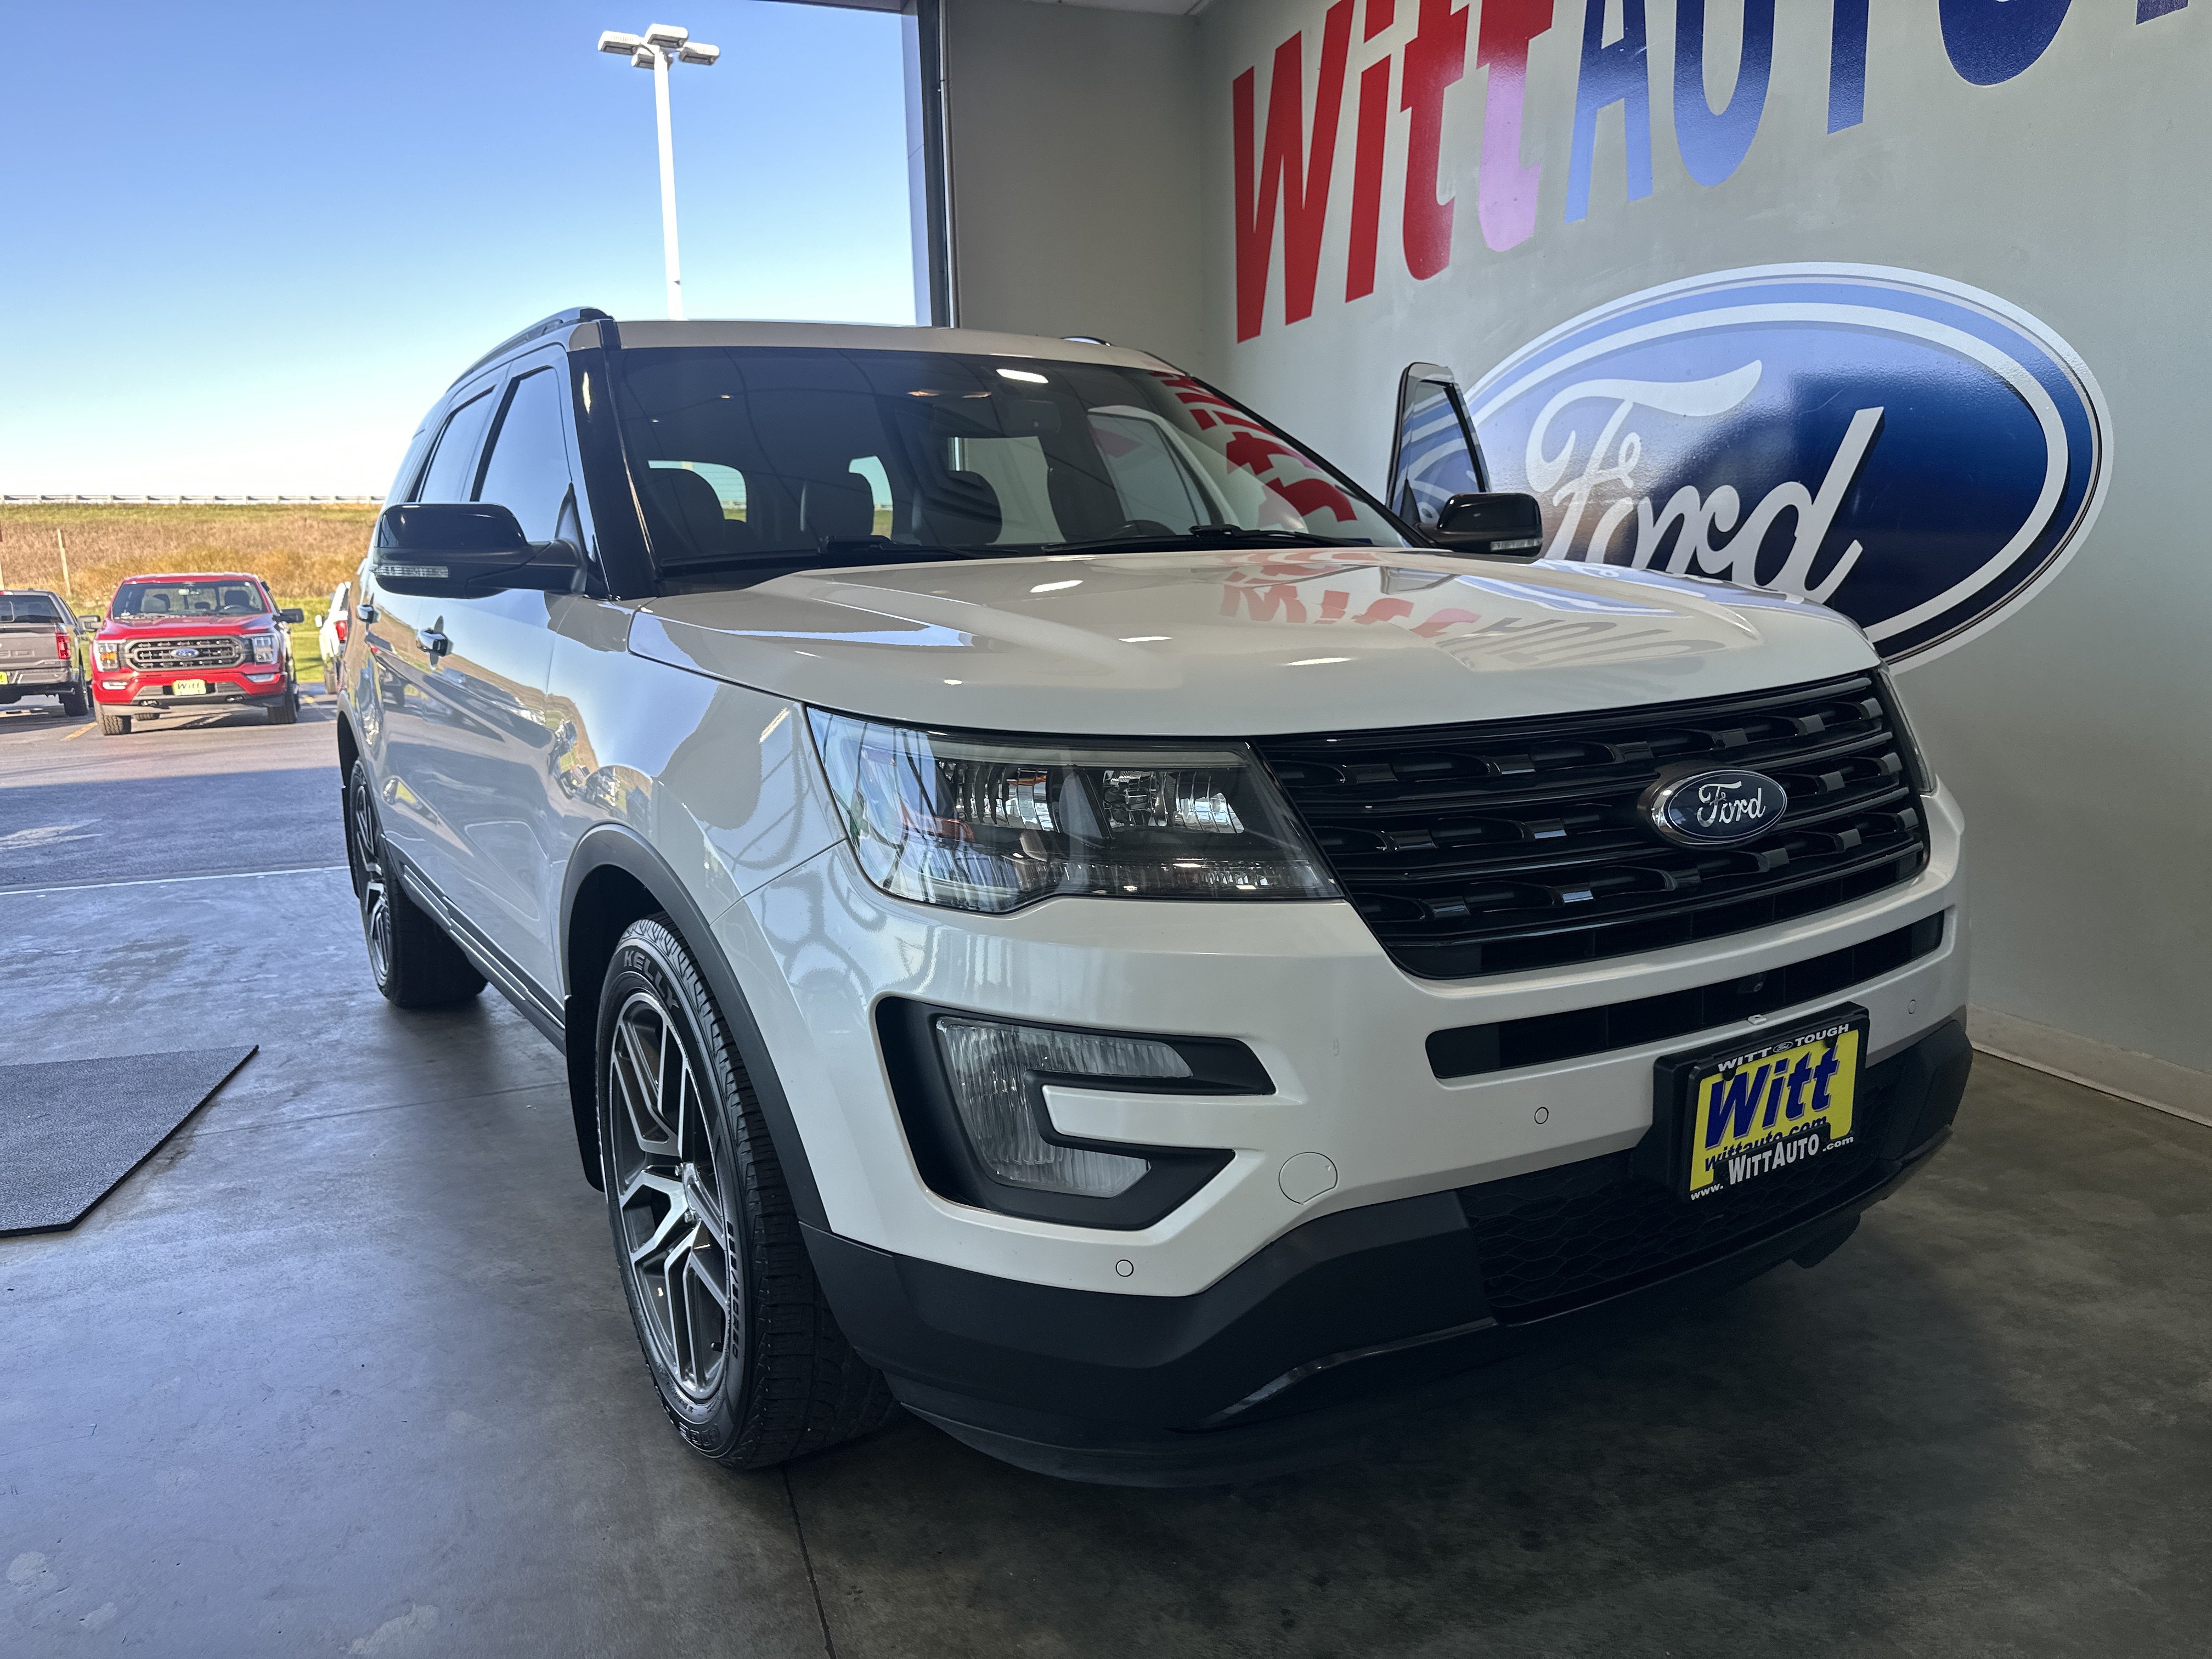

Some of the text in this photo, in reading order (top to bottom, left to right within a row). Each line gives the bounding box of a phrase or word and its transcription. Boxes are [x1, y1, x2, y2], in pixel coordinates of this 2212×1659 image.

[1525, 359, 1884, 603] Ford
[1696, 780, 1766, 828] Ford
[623, 950, 680, 1010] KELLY
[1717, 1046, 1772, 1072] WITT
[1795, 1023, 1849, 1047] TOUGH
[1705, 1043, 1841, 1151] Witt
